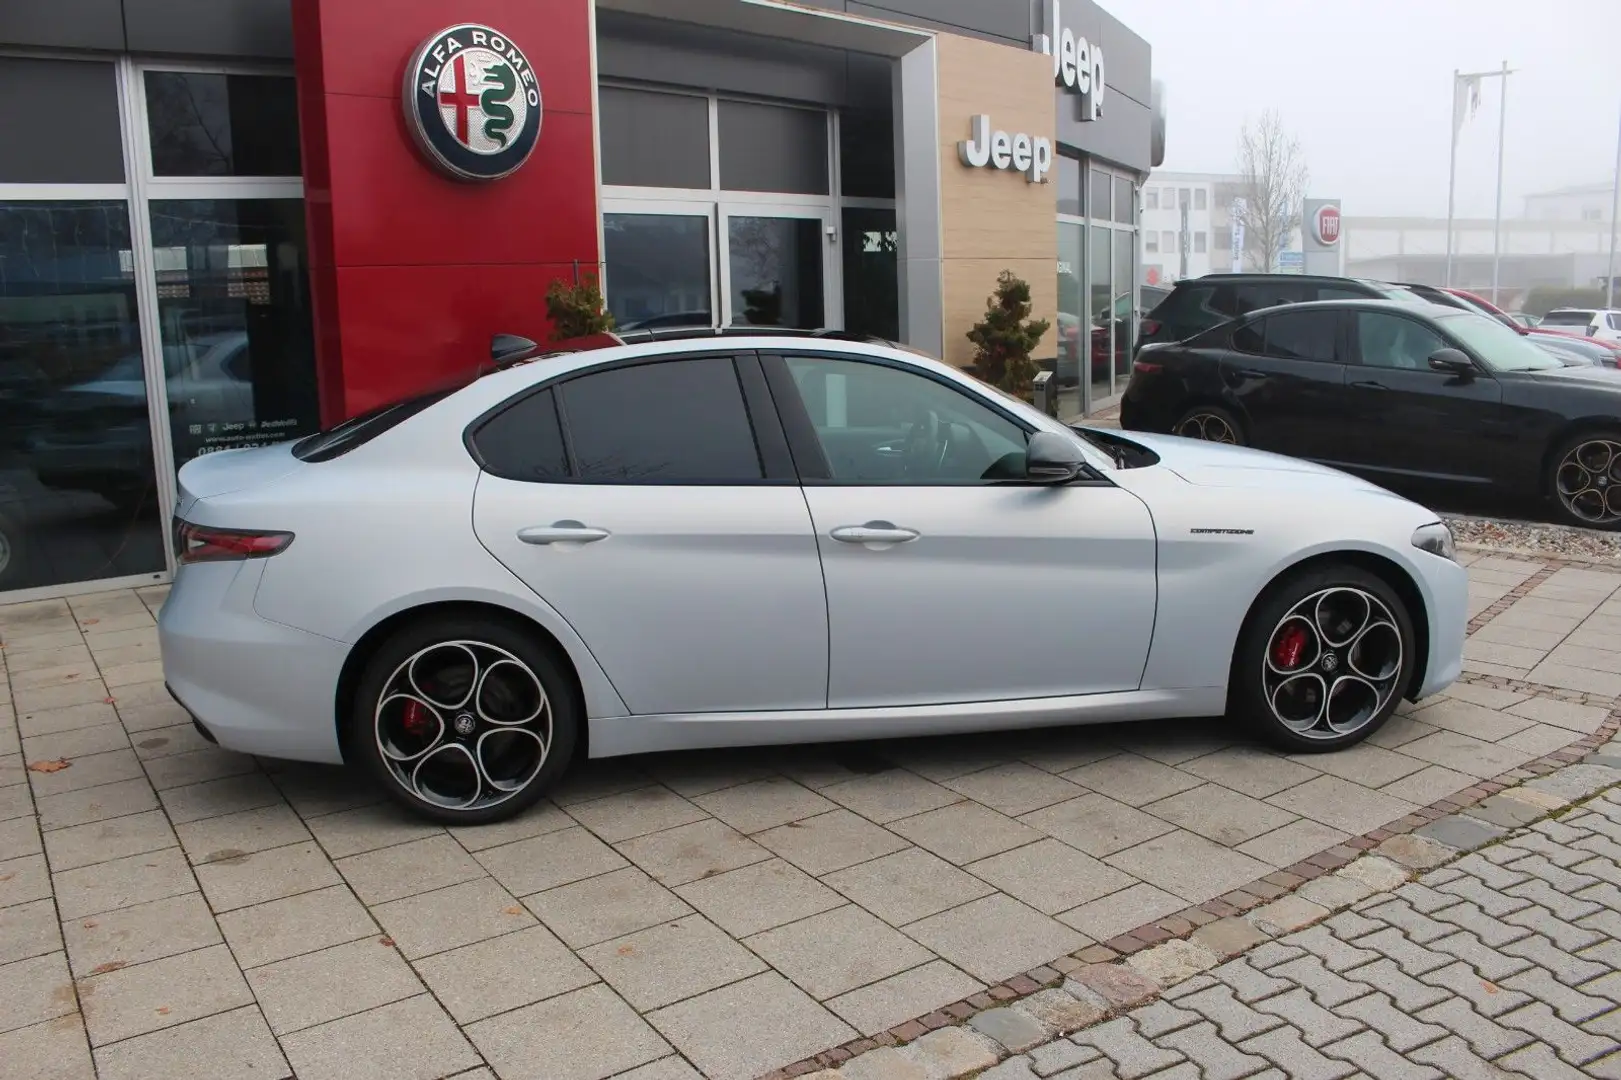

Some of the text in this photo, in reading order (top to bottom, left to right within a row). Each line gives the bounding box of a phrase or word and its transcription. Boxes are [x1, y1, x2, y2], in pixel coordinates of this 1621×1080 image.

[420, 30, 539, 107] ALFA ROMEO
[1040, 0, 1105, 122] Jeep
[960, 114, 1051, 183] Jeep
[1322, 216, 1339, 236] FIAT
[222, 422, 245, 431] Jeep
